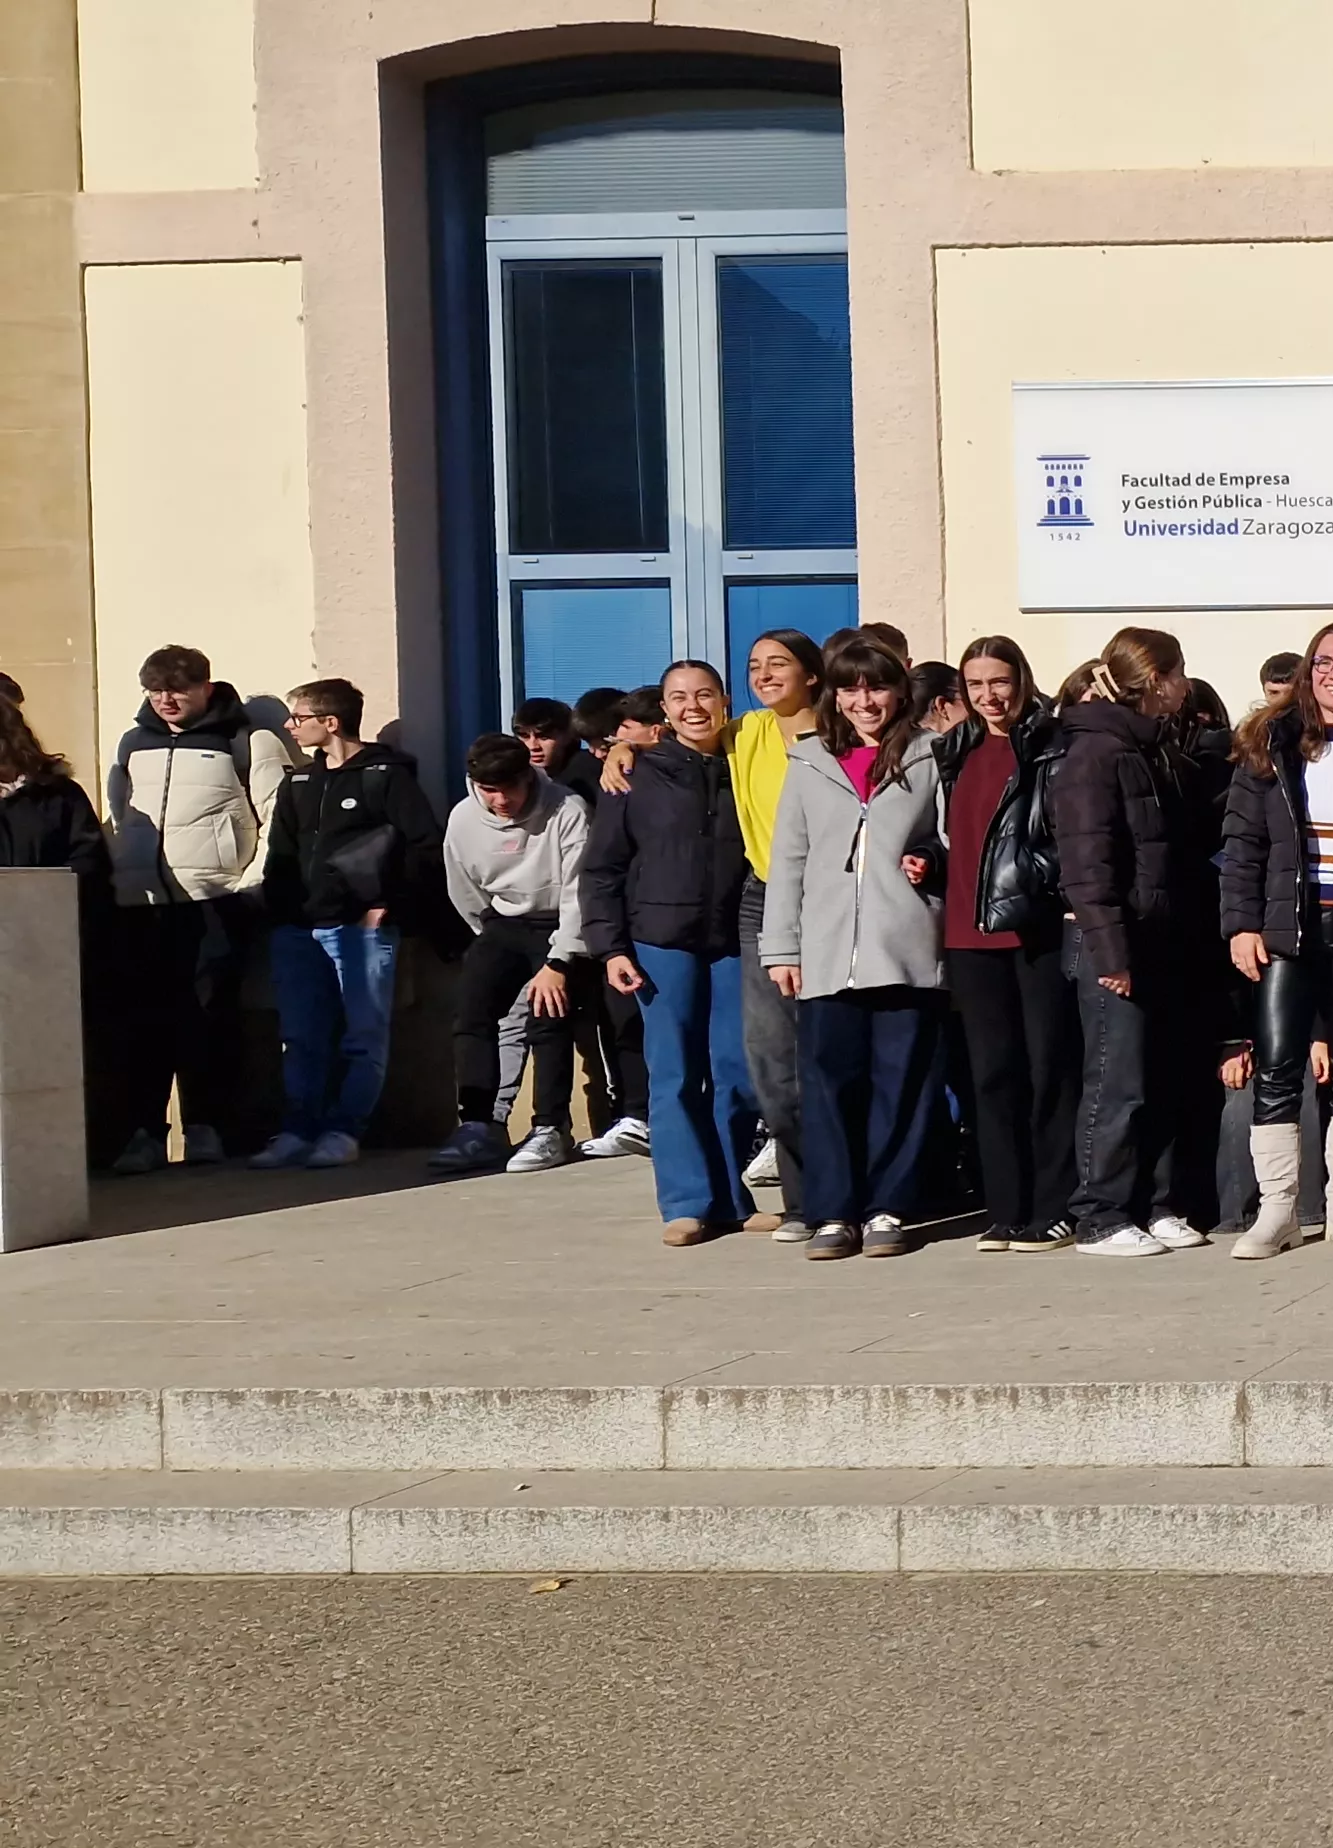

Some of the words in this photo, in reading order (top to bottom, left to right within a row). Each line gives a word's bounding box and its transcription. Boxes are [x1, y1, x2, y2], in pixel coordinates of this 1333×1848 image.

[1121, 472, 1192, 488] Facultad
[1194, 471, 1216, 487] de
[1219, 472, 1290, 490] Empresa
[1121, 498, 1131, 514] y
[1134, 494, 1199, 510] Gestión
[1202, 493, 1263, 509] Pública
[1275, 493, 1333, 508] Huesca
[1123, 517, 1239, 537] Universidad
[1049, 532, 1081, 542] 1542
